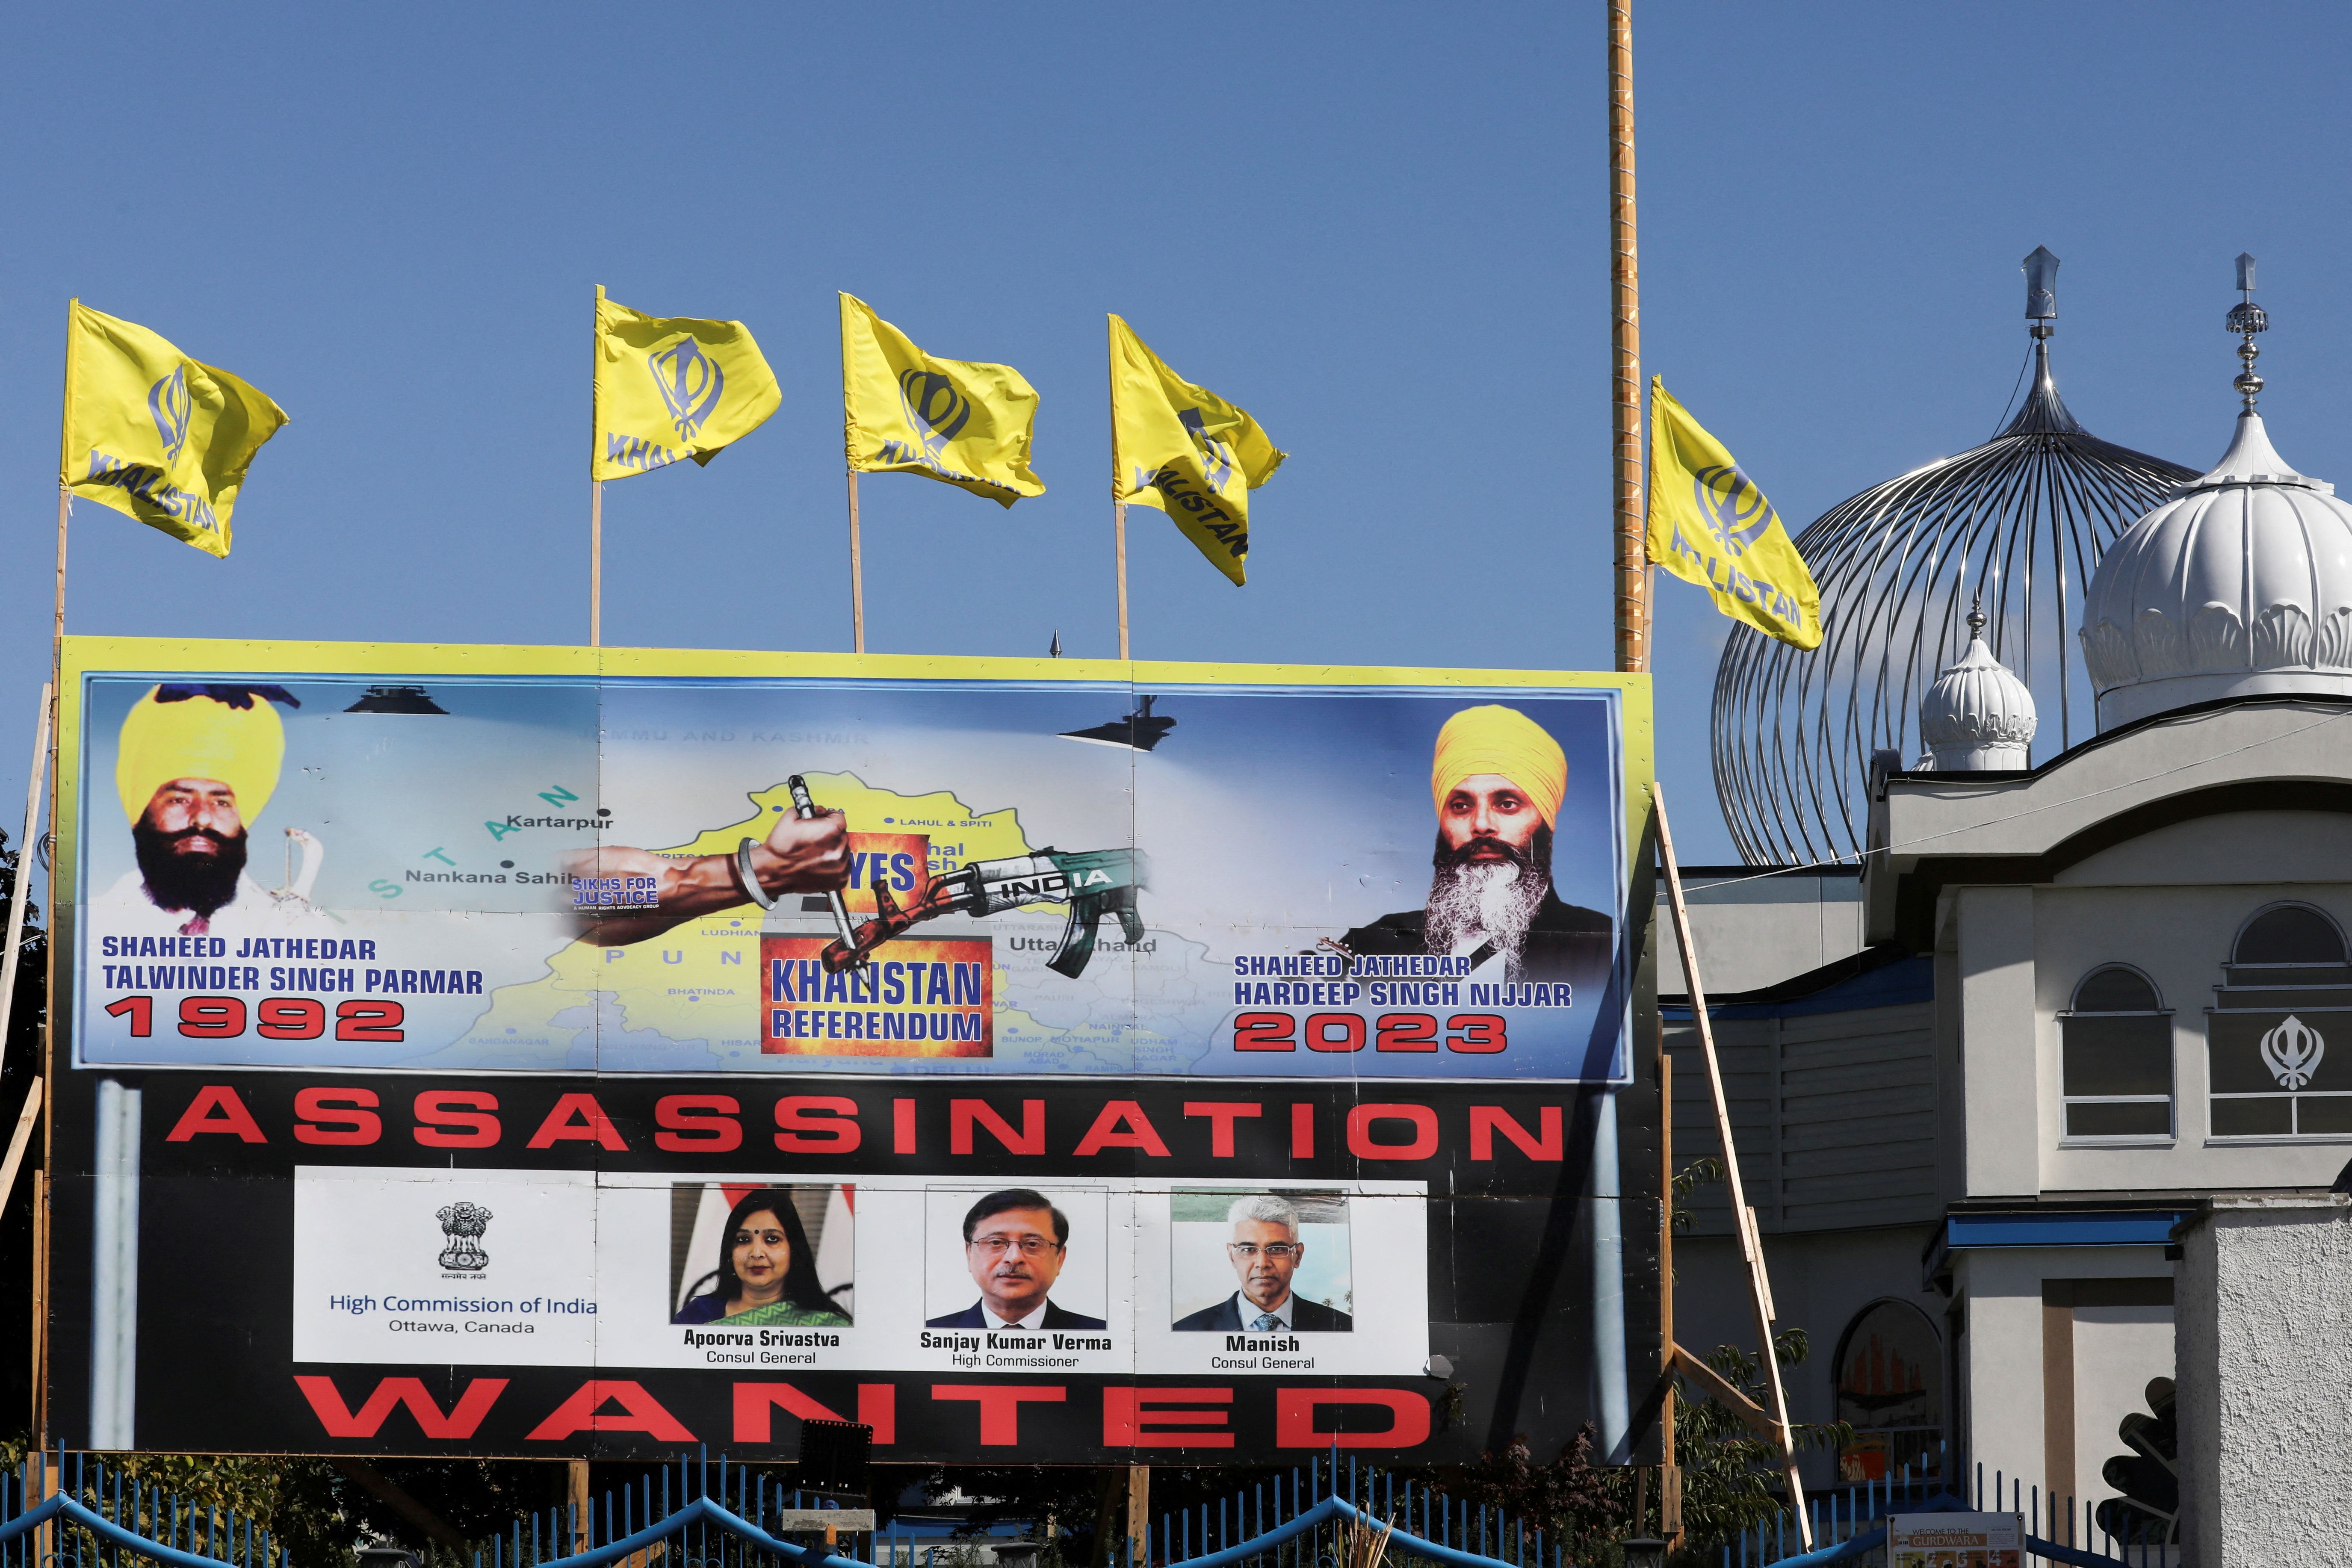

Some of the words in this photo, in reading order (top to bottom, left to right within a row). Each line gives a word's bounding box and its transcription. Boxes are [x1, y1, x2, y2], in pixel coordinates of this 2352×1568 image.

[87, 449, 219, 534] KHALISTAN
[506, 815, 614, 830] Kartarpur
[405, 869, 507, 883] Nankana
[847, 852, 915, 892] YES
[572, 877, 621, 891] SIKHS
[626, 877, 657, 889] FOR
[1001, 869, 1113, 898] INDIA
[573, 890, 659, 905] JUSTICE
[102, 935, 226, 959] SHAHEED
[236, 937, 376, 961] JATHEDAR
[1010, 937, 1156, 952] Uttahand
[1233, 955, 1342, 977] SHAHEED
[1349, 955, 1471, 978] JATHEDAR
[103, 965, 259, 992] TALWINDER
[270, 966, 355, 993] SINGH
[366, 969, 483, 995] PARMAR
[771, 958, 982, 1006] KHALISTAN
[1233, 980, 1361, 1007] HARDEEP
[1368, 981, 1460, 1007] SINGH
[1470, 982, 1572, 1008] NIJJAR
[104, 995, 405, 1043] 1992
[771, 1008, 982, 1042] REFERENDUM
[1233, 1012, 1507, 1054] 2023
[165, 1085, 1564, 1162] ASSASSINATION
[330, 1295, 376, 1314] High
[384, 1296, 513, 1312] Commission
[520, 1297, 542, 1314] of
[548, 1298, 597, 1314] India
[389, 1320, 458, 1334] Ottawa,
[465, 1321, 534, 1333] Canada
[684, 1329, 753, 1349] Apoorva
[760, 1330, 839, 1347] Srivastva
[921, 1332, 980, 1352] Sanjay
[987, 1333, 1046, 1349] Kumar
[1053, 1334, 1111, 1350] Verma
[1226, 1335, 1299, 1352] Manish
[707, 1351, 754, 1363] Consul
[760, 1352, 816, 1364] General
[952, 1354, 981, 1368] High
[987, 1355, 1079, 1367] Commissioner
[1212, 1357, 1256, 1368] Consul
[1262, 1357, 1314, 1368] General
[293, 1375, 1431, 1450] WANTED
[1913, 1536, 1979, 1546] GURDWARA
